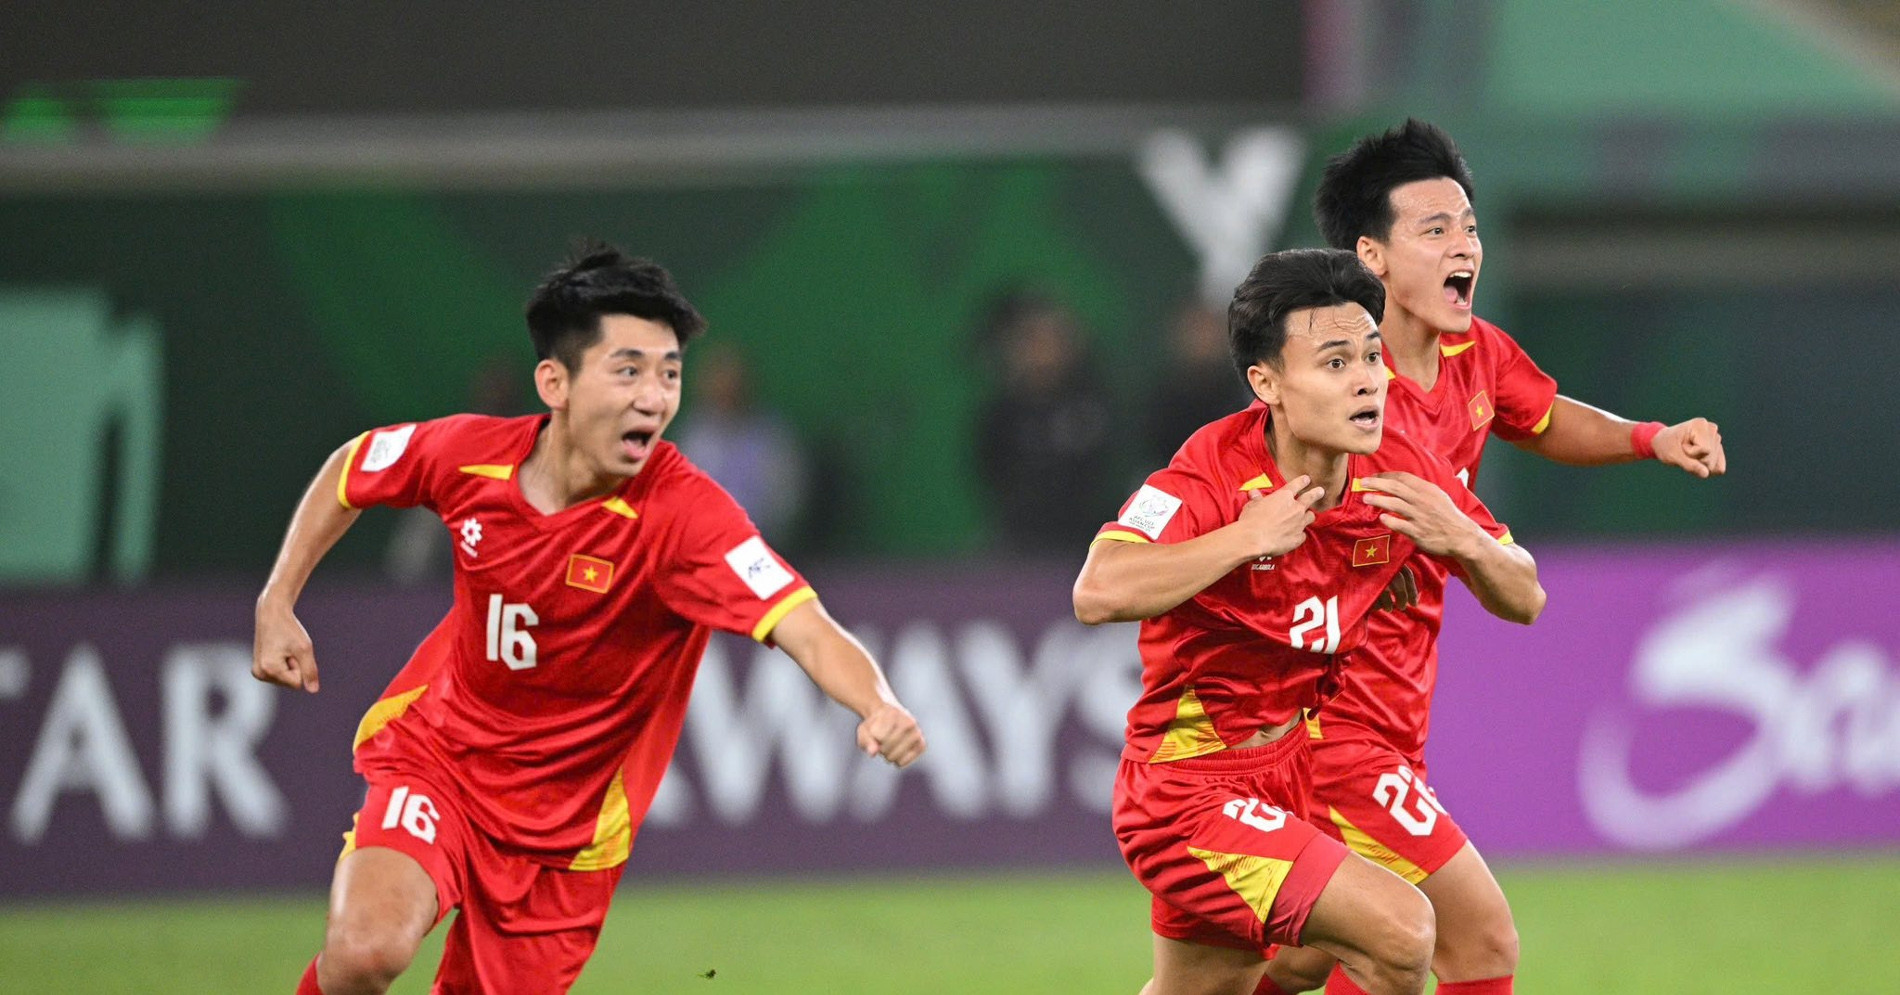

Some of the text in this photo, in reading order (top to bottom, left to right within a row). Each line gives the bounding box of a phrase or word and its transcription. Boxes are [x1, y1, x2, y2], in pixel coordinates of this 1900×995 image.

[486, 593, 539, 671] 16
[1289, 595, 1342, 655] 21
[0, 616, 1142, 842] AR WAYS
[381, 786, 441, 844] 16
[1222, 797, 1295, 833] 2
